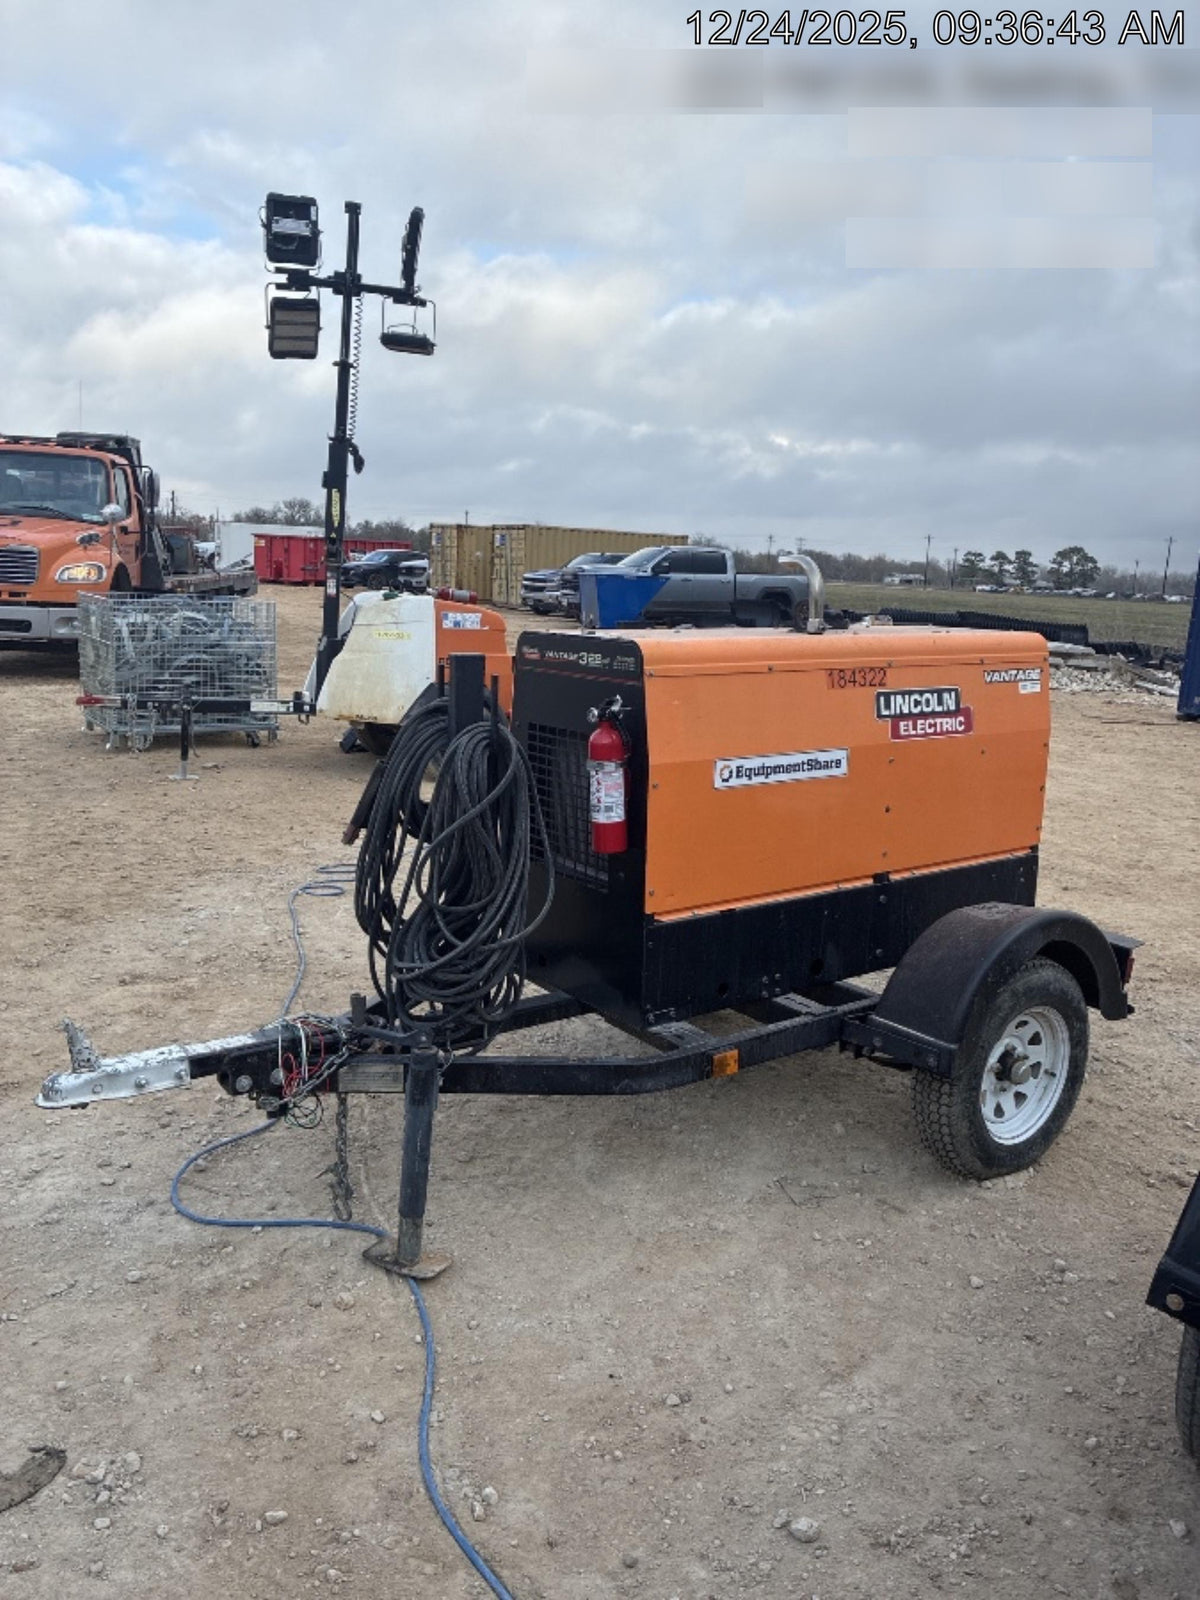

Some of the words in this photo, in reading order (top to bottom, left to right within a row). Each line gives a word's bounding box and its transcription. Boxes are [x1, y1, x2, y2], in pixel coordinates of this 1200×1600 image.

[827, 668, 887, 689] 184322
[984, 669, 1041, 683] VANTAGE
[879, 690, 956, 716] LINCOLN
[899, 716, 965, 736] ELECTRIC
[735, 757, 842, 781] EquipmentShare
